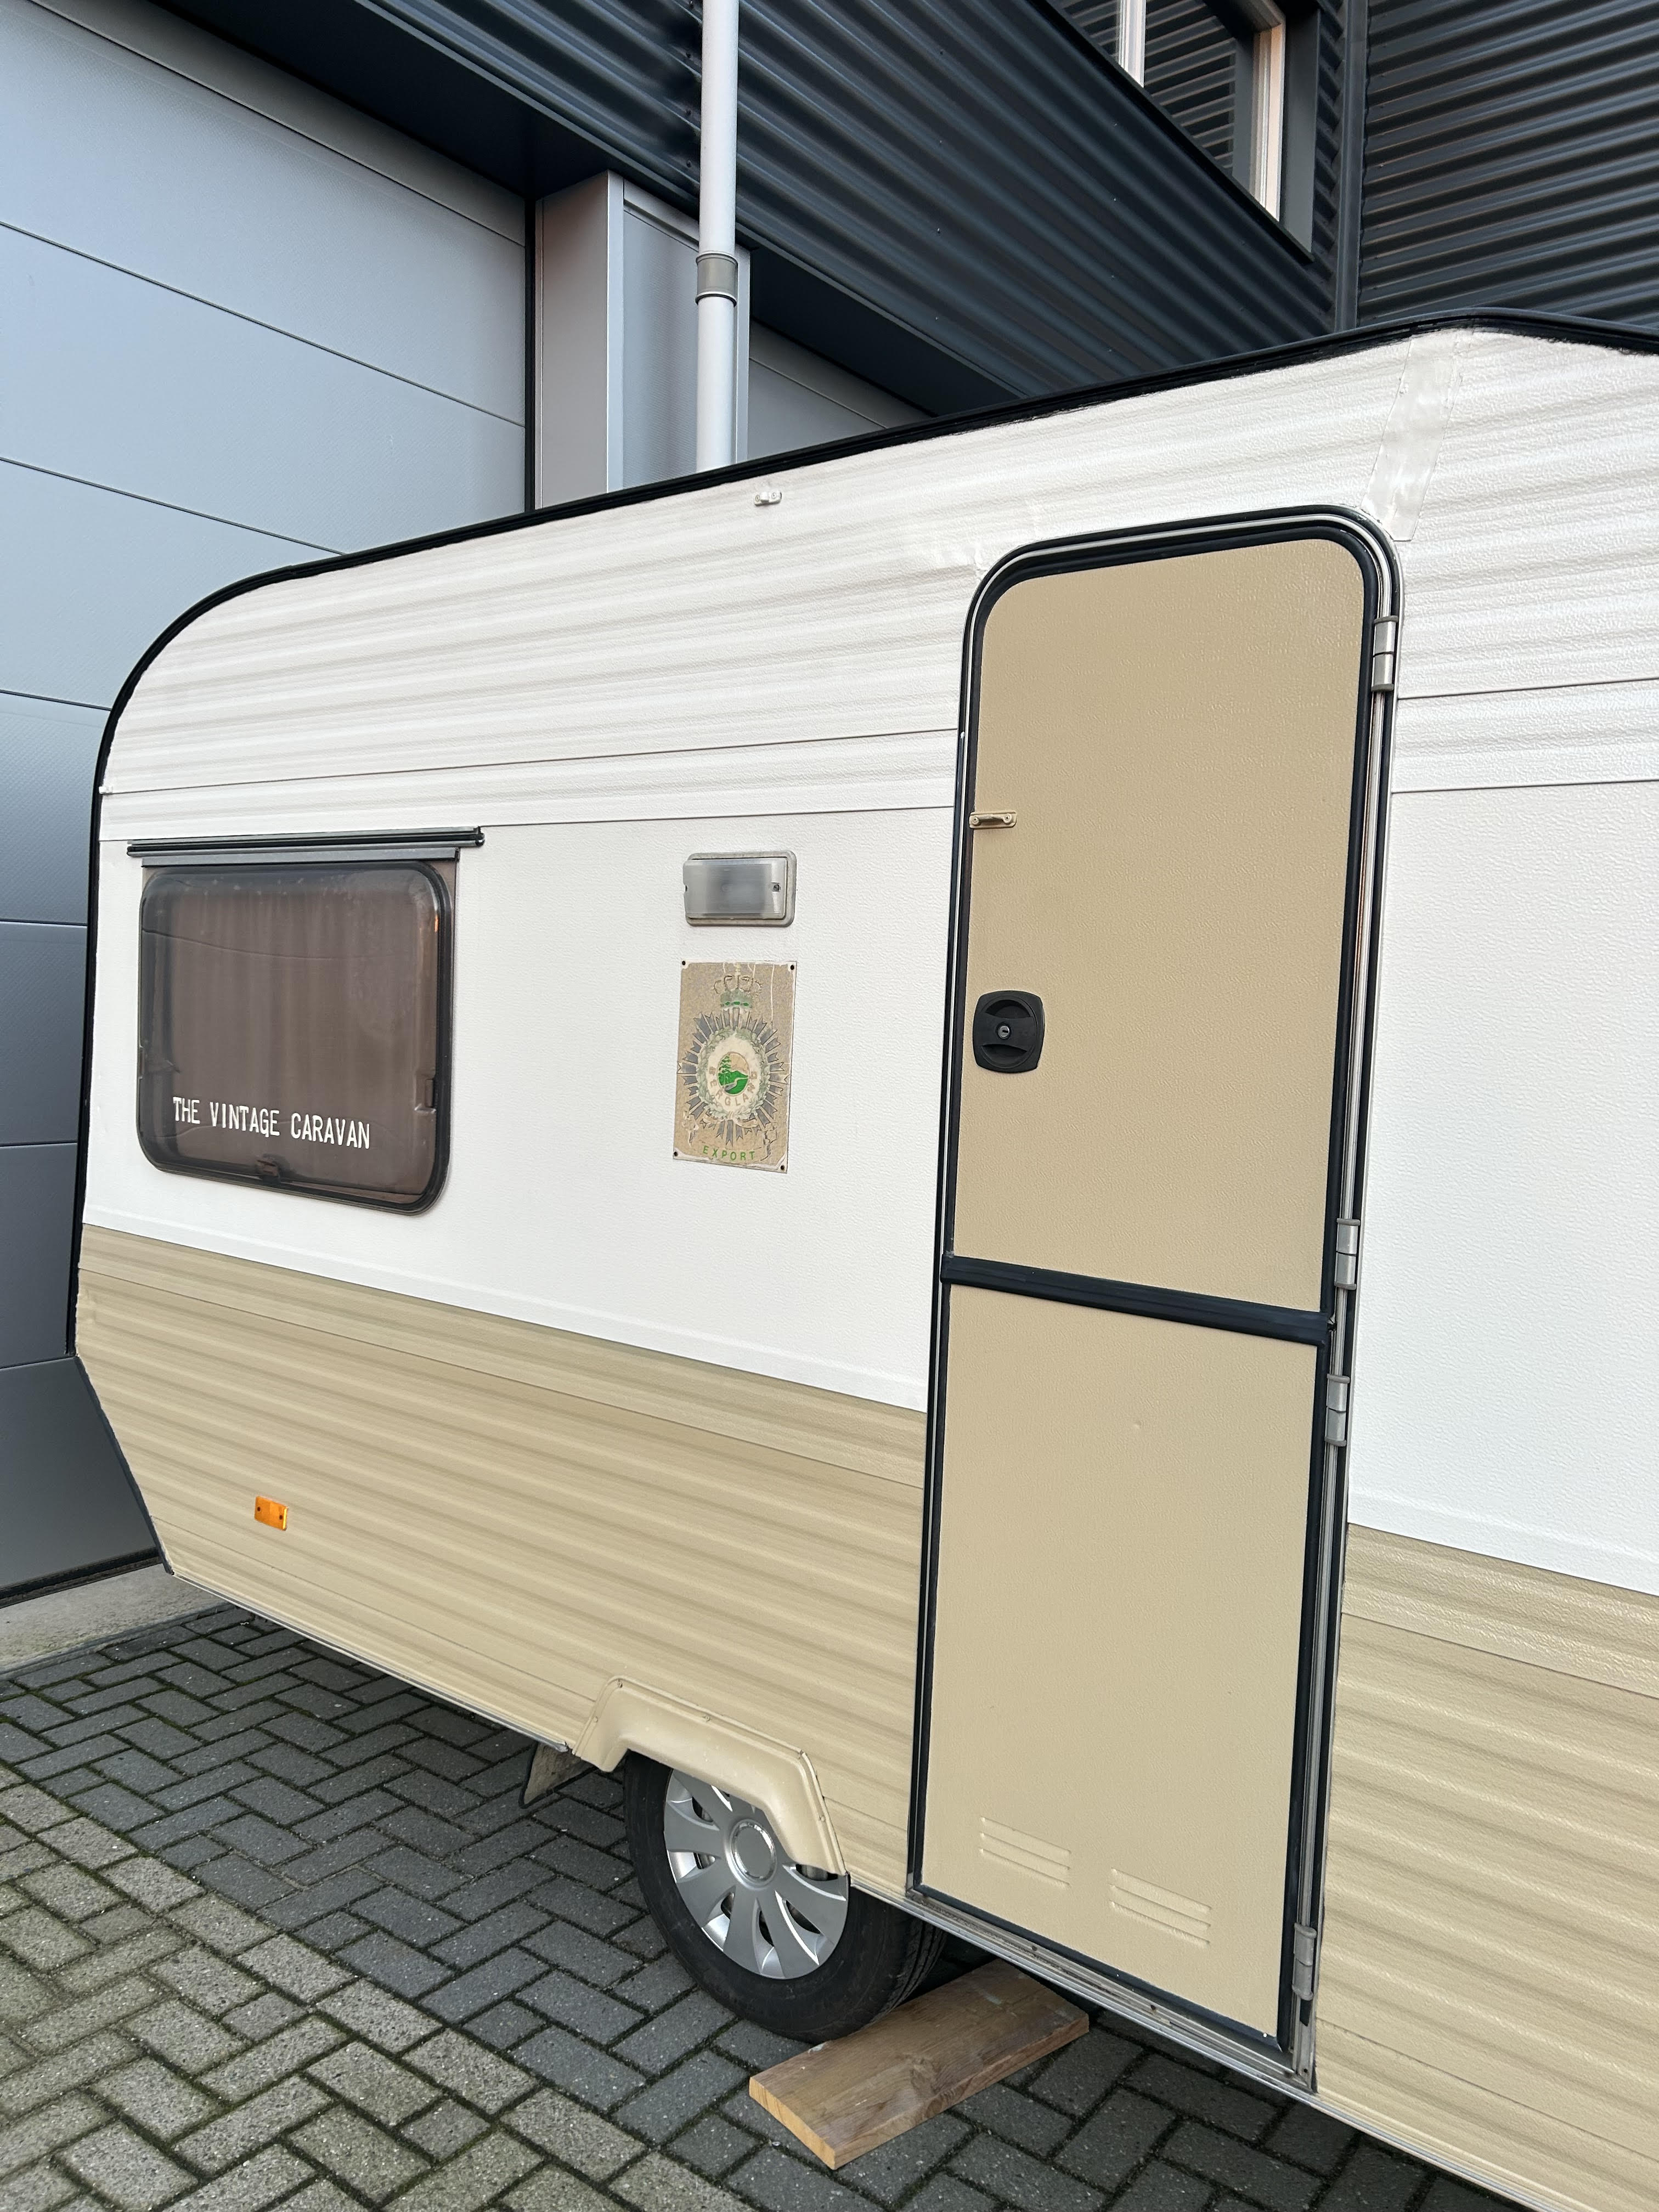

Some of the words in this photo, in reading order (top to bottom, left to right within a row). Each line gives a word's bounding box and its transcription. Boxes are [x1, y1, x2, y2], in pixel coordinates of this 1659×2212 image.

[709, 1066, 758, 1107] BERGLAND
[172, 1096, 200, 1124] THE
[210, 1101, 280, 1138] VINTAGE
[290, 1113, 370, 1149] CARAVAN
[702, 1145, 755, 1161] EXPORT
